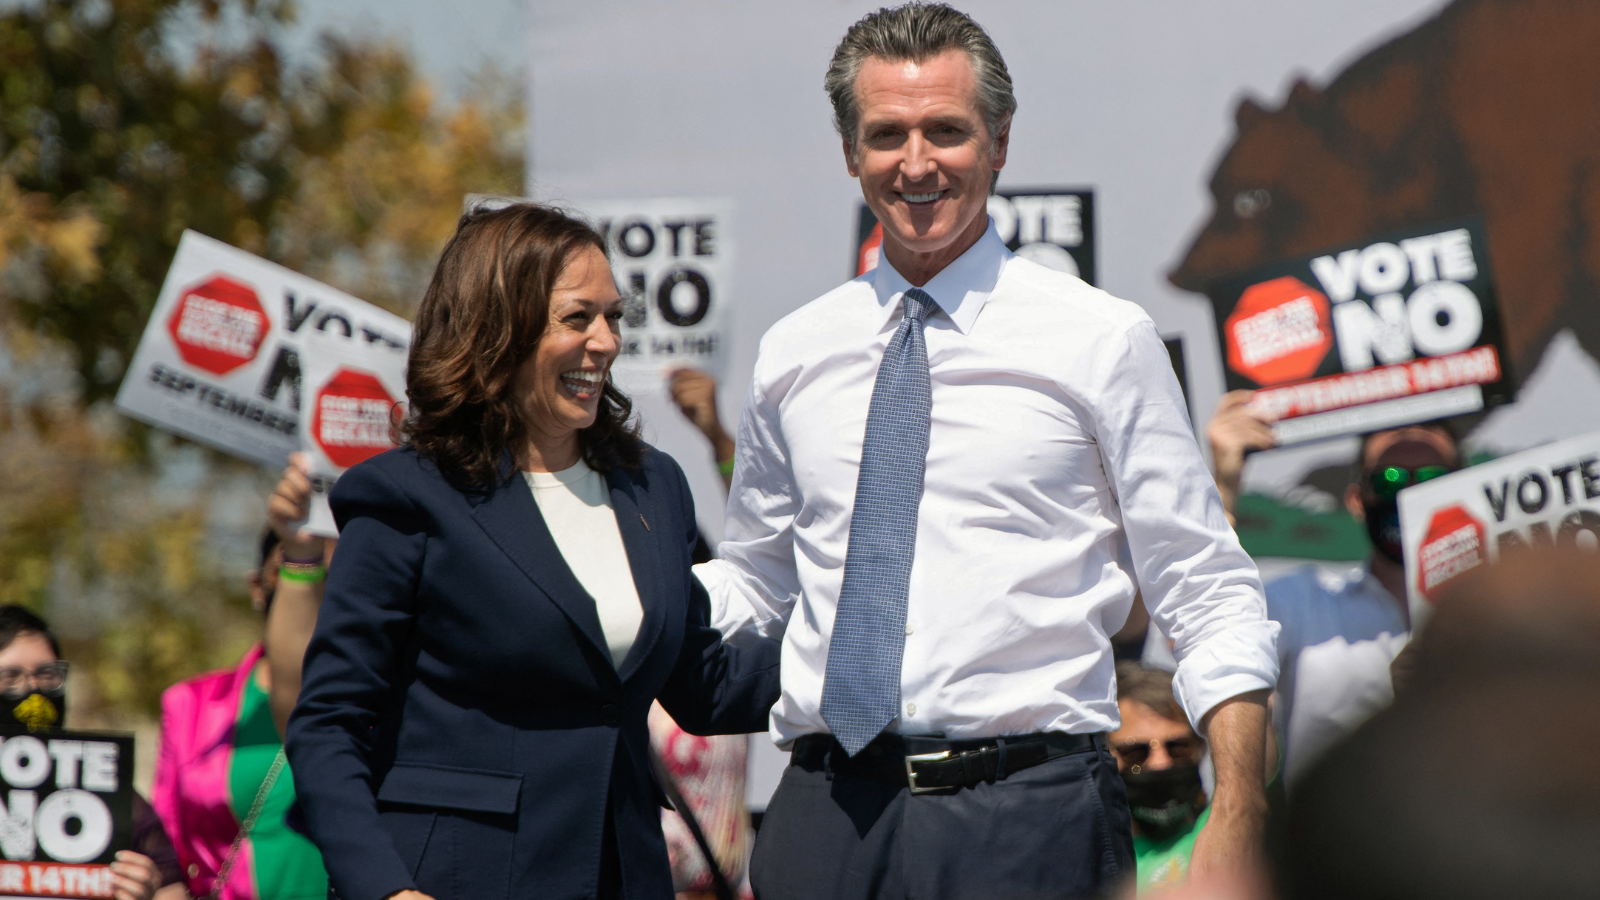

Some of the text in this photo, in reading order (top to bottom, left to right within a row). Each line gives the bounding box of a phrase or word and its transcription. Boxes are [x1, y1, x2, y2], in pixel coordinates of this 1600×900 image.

[985, 194, 1084, 248] OTE
[1309, 228, 1478, 302] VOTE
[1332, 280, 1484, 372] NO
[149, 362, 298, 434] SEPTEMBER
[1252, 364, 1411, 420] EPTEMBER
[0, 735, 119, 792] OTE
